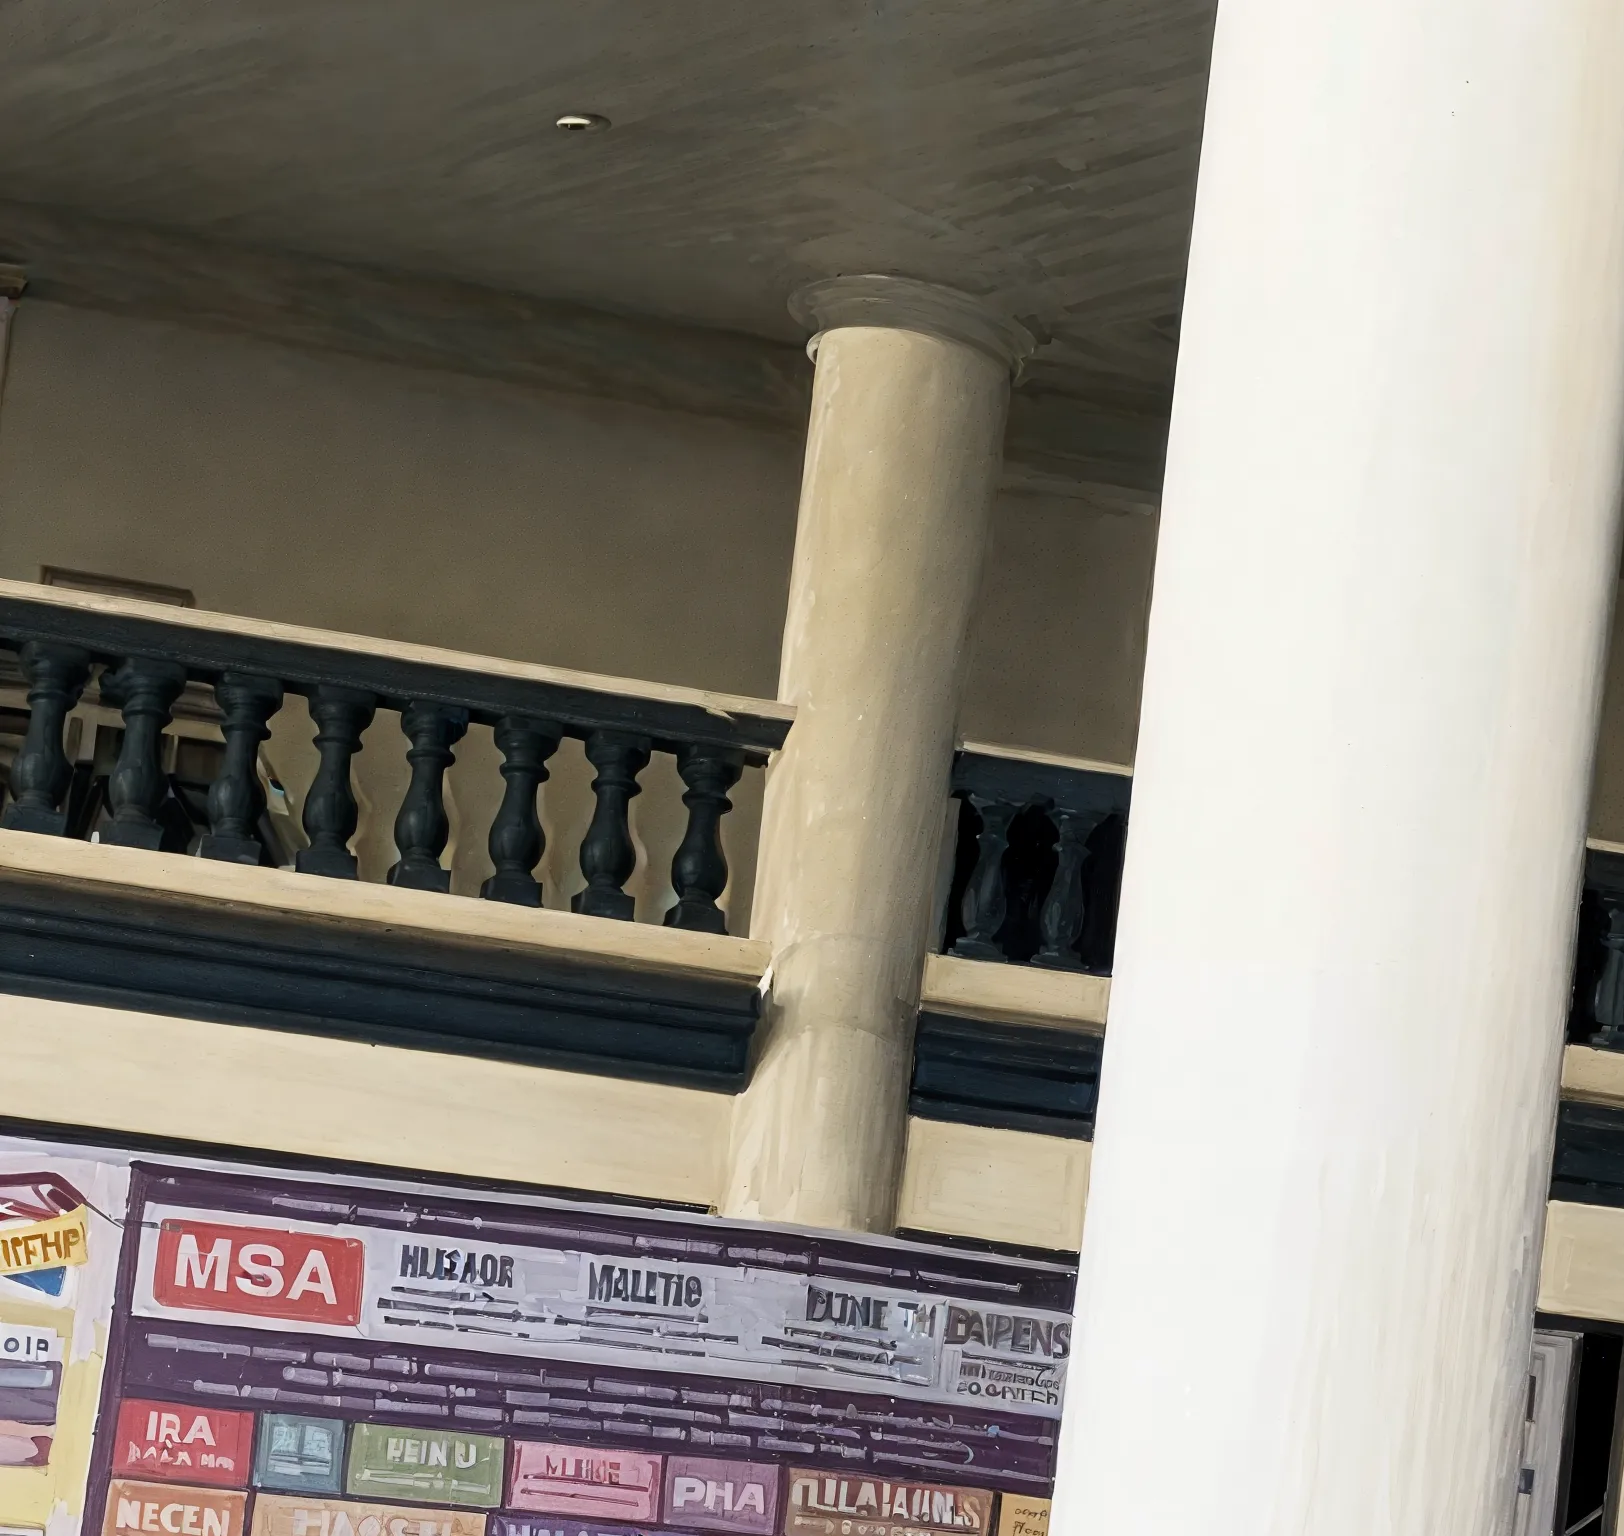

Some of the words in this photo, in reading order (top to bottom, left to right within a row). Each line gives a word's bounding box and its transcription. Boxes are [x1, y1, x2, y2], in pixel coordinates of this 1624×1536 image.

[173, 1234, 338, 1306] MSA
[145, 1410, 216, 1447] IRA
[672, 1475, 766, 1515] PHA
